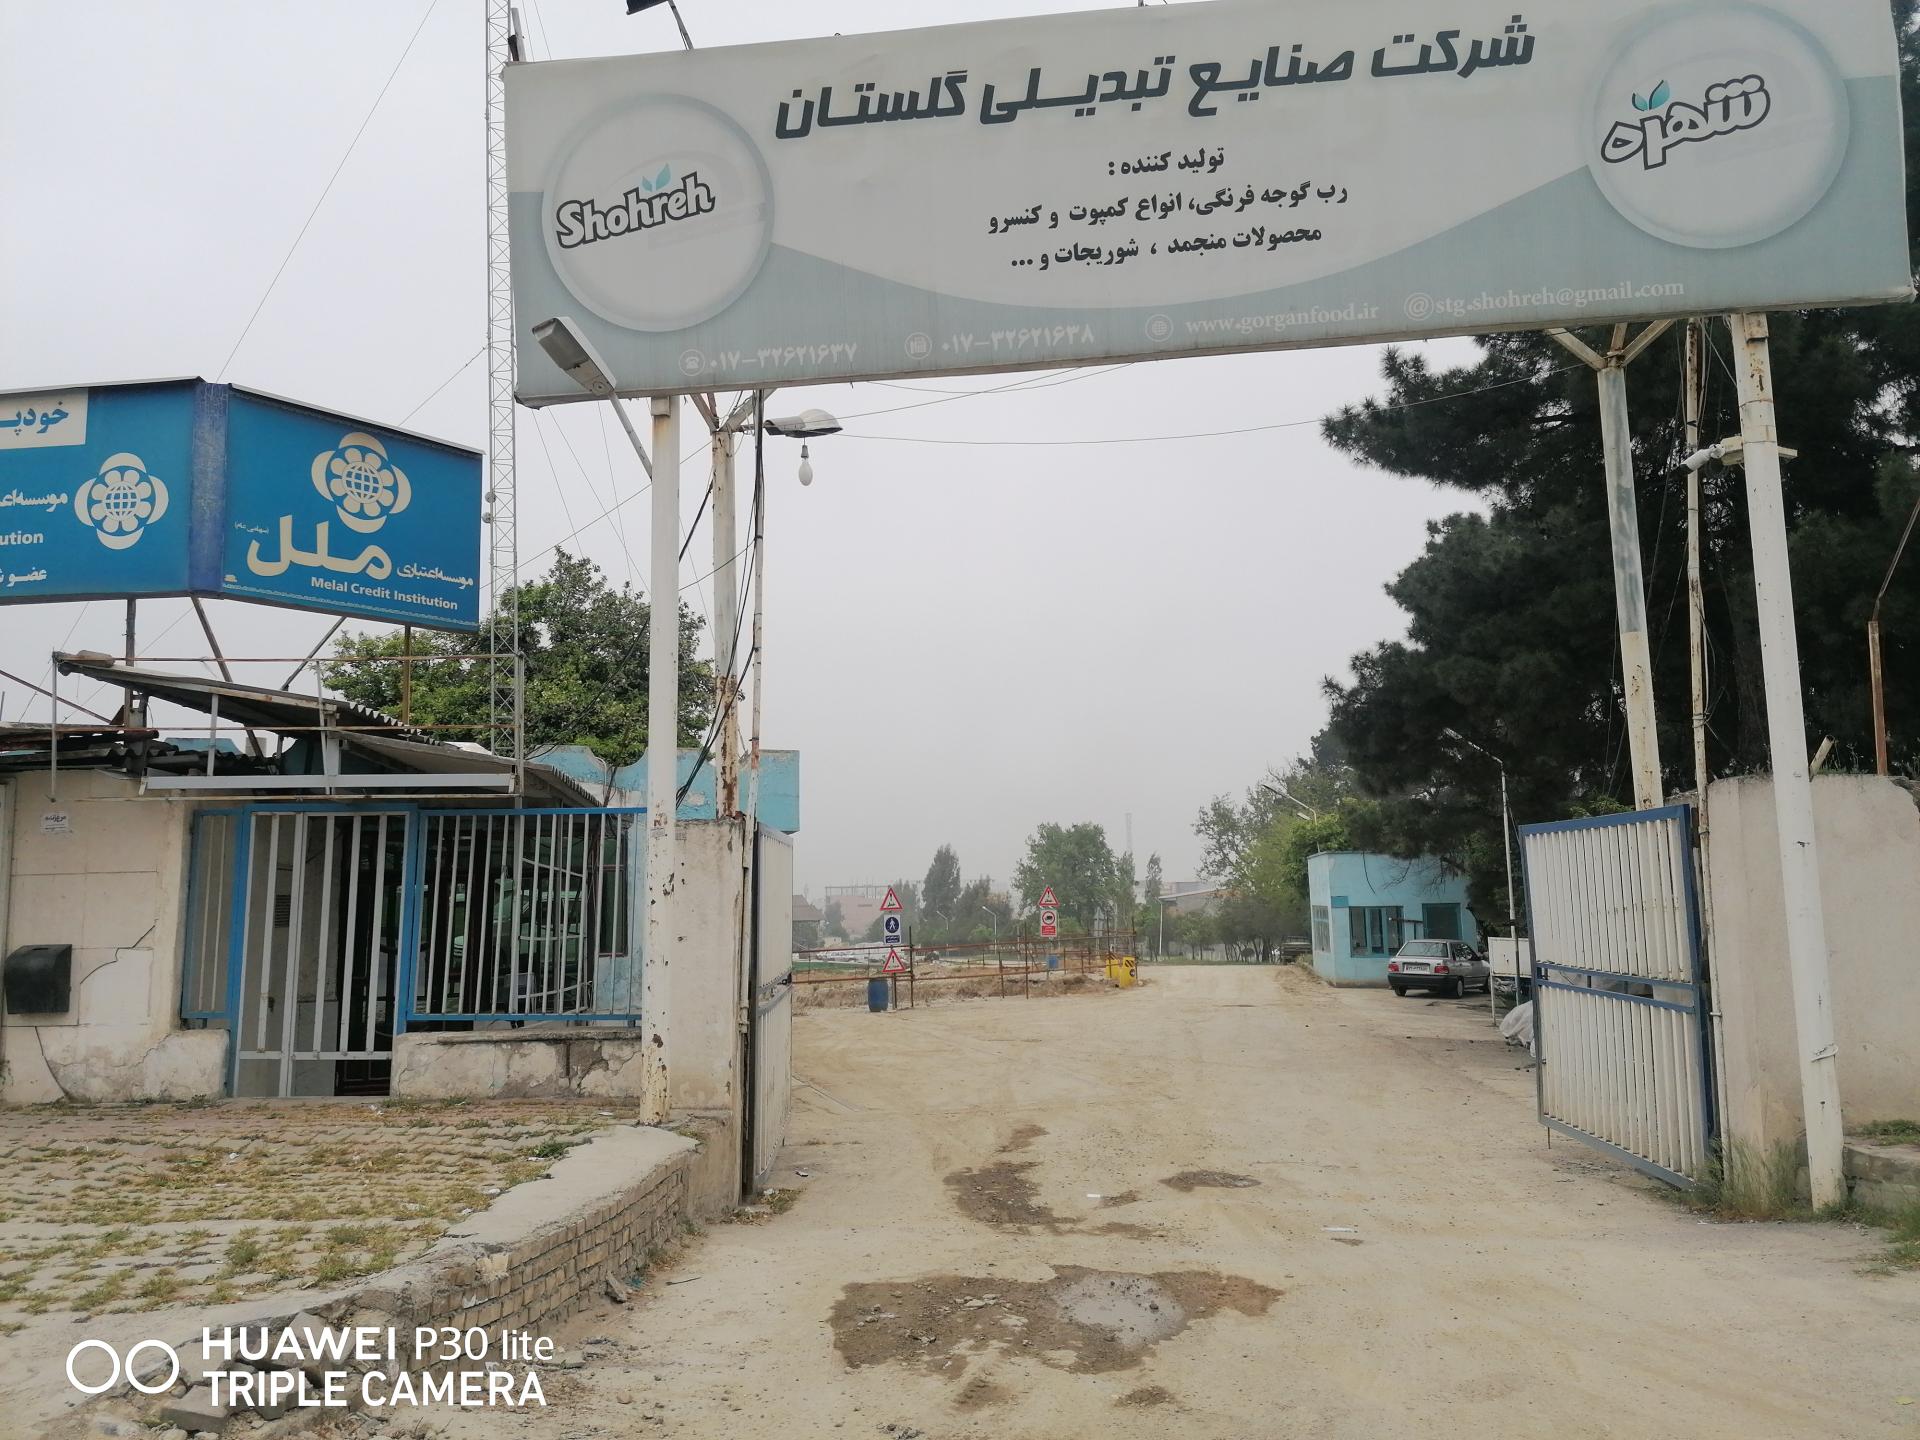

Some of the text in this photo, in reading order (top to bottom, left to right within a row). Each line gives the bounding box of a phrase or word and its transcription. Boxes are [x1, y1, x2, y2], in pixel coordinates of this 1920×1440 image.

[774, 14, 1535, 140] شرکت صنایع تبدیلی گلستان
[1600, 74, 1771, 170] شهره
[1120, 151, 1172, 175] کننده
[1177, 147, 1225, 173] تولید
[1135, 192, 1183, 221] انواع
[1260, 180, 1311, 208] گوجه
[1316, 183, 1348, 204] رب
[556, 171, 716, 249] Shohreh
[988, 204, 1043, 234] کنسرو
[1048, 210, 1059, 229] و
[1068, 196, 1129, 226] کمپوت
[1054, 238, 1140, 265] شوریجات
[1167, 233, 1227, 256] منجمد
[1233, 225, 1322, 251] محصولات
[1038, 253, 1050, 270] و
[1433, 281, 1685, 317] stg.shohreh@gmail.com
[1184, 303, 1380, 334] www.gorganfood.ir
[0, 400, 69, 437] خودپ
[0, 530, 44, 546] ution
[247, 514, 393, 580] ملل
[6, 566, 48, 588] عضو
[311, 577, 458, 611] Melal Credit Institution
